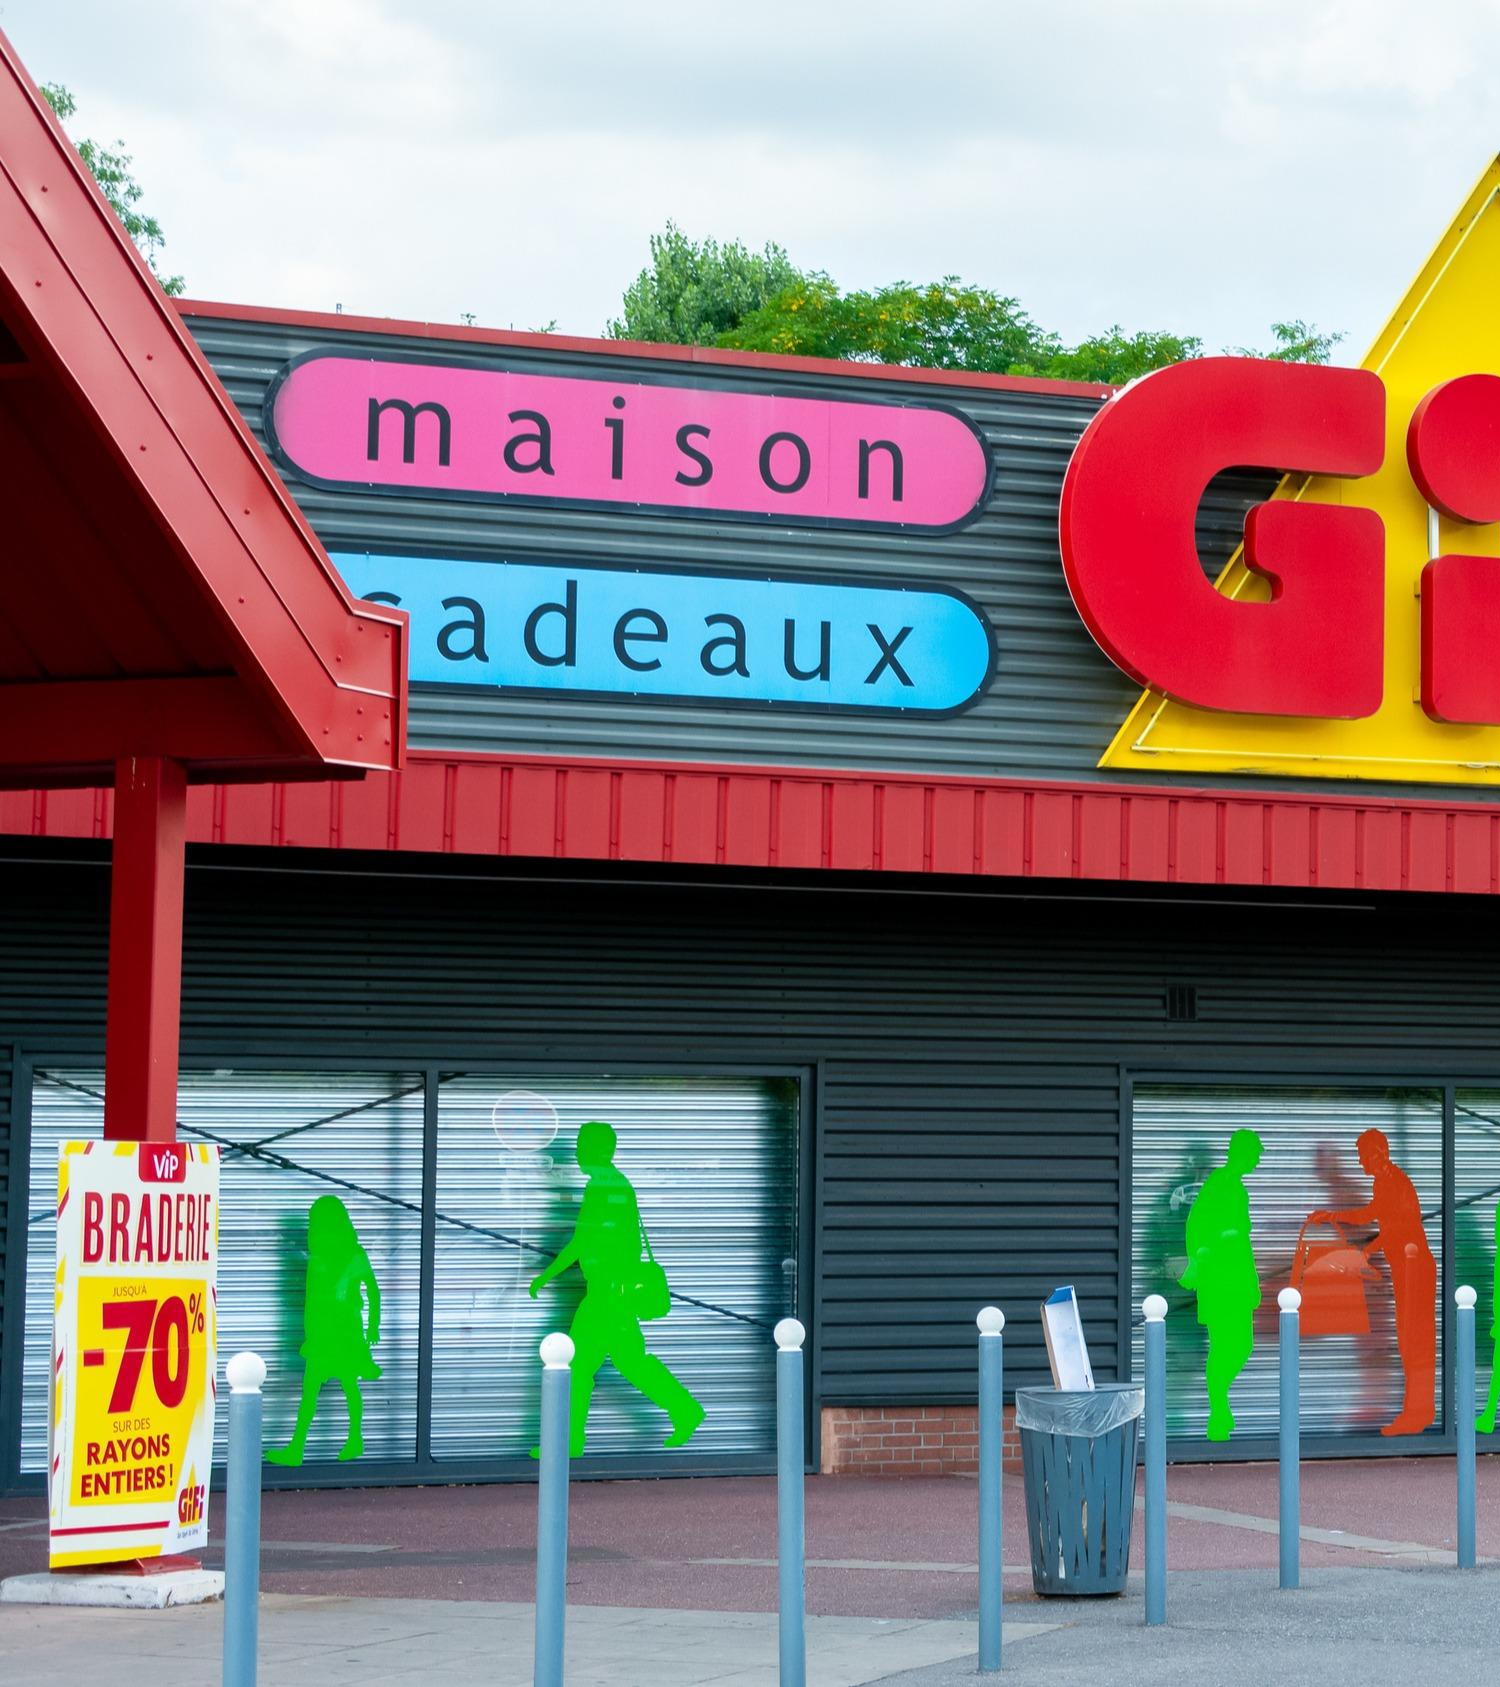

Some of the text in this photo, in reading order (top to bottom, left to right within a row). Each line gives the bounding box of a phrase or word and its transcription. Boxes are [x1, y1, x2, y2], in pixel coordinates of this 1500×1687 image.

[367, 396, 904, 501] maison
[361, 580, 914, 687] adeaux
[83, 1192, 211, 1263] BRADERIE
[87, 1433, 170, 1466] RAYONS
[113, 1417, 151, 1433] SUR DES
